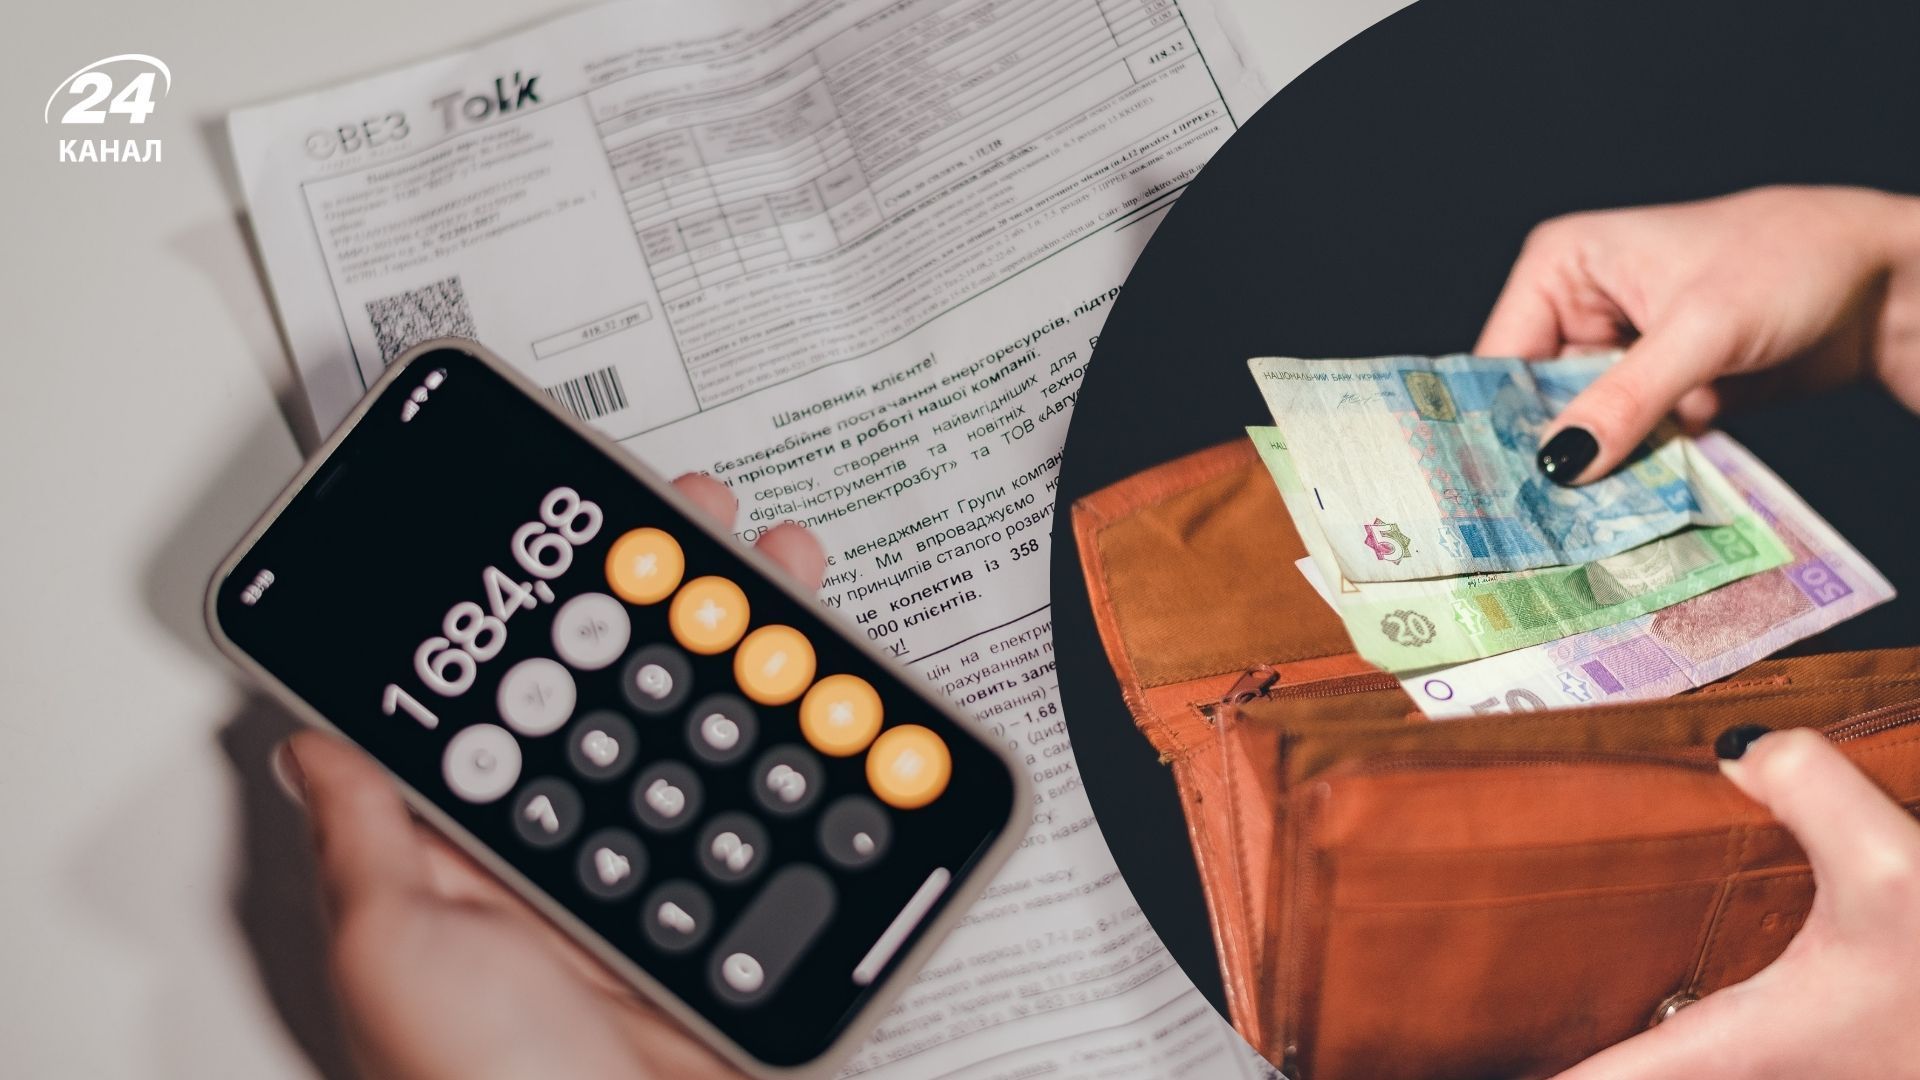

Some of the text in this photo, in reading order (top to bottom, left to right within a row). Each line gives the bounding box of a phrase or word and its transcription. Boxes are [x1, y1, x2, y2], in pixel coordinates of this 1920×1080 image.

[713, 426, 831, 486] безперебійне
[837, 382, 937, 430] постачання
[941, 317, 1069, 385] енергоресурсів,
[1073, 286, 1122, 317] підтр
[772, 352, 935, 428] Шановний клієнте!
[1263, 371, 1329, 382] НАЦІОНАЛЬНИЙ
[1332, 373, 1353, 381] БАНК
[738, 347, 1040, 483] пріоритети в роботі нашої компанії.
[754, 477, 819, 509] сервісу,
[833, 433, 919, 476] створення
[932, 374, 1037, 434] найвигідніших
[1049, 350, 1077, 376] для
[970, 445, 990, 460] та
[1000, 418, 1035, 444] ТОВ
[749, 443, 906, 520] digital-інструментів
[926, 442, 947, 456] та
[966, 404, 1025, 441] новітніх
[820, 568, 862, 588] инку.
[874, 551, 903, 569] Ми
[916, 493, 1034, 552] впроваджуємо
[844, 509, 948, 560] менеджмент
[956, 486, 1005, 513] Групи
[1369, 523, 1405, 562] 5
[846, 559, 932, 600] принципів
[936, 531, 1001, 563] сталого
[855, 538, 1039, 624] це колектив із 358
[379, 485, 604, 729] 1 684,68
[866, 590, 981, 640] 000 клієнтів.
[1388, 614, 1432, 644] 20
[926, 663, 950, 681] цін
[959, 651, 979, 666] на
[1024, 701, 1057, 722] 1,68
